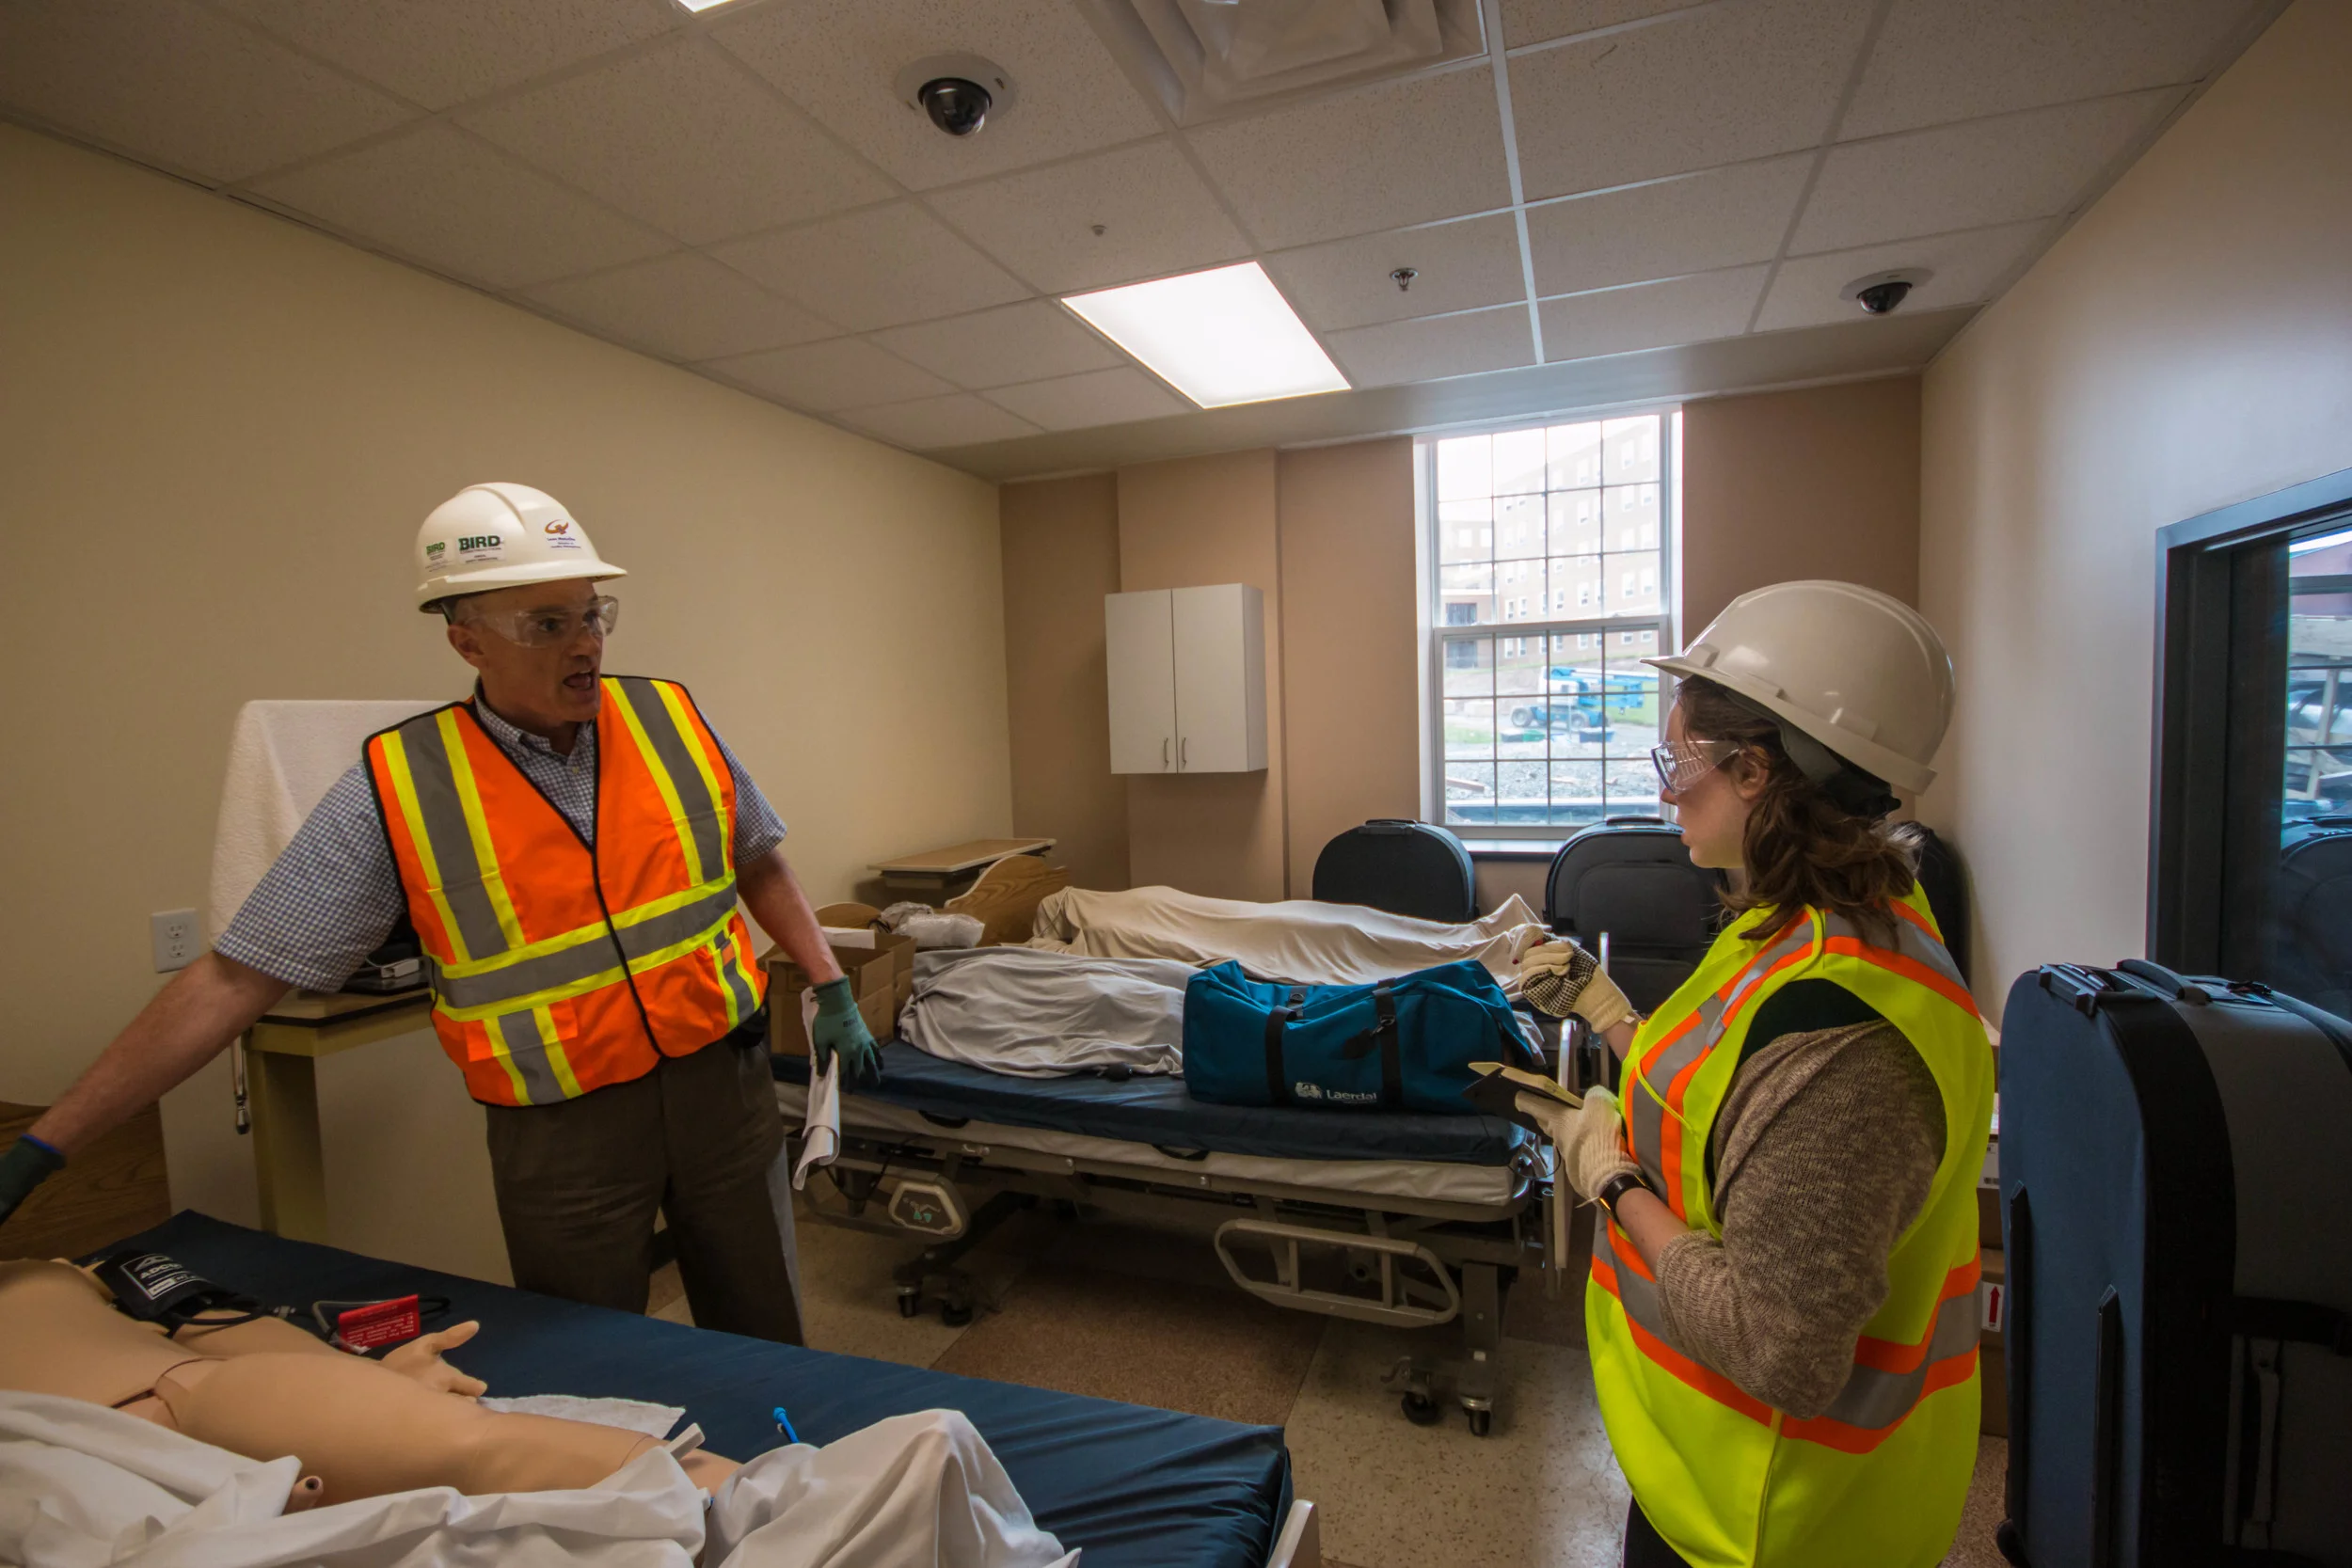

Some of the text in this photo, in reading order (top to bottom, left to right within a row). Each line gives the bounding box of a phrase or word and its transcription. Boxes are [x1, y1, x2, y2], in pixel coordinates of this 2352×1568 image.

[426, 542, 445, 555] BIRD
[458, 535, 501, 551] BIRD
[1327, 1089, 1377, 1100] Laerdal
